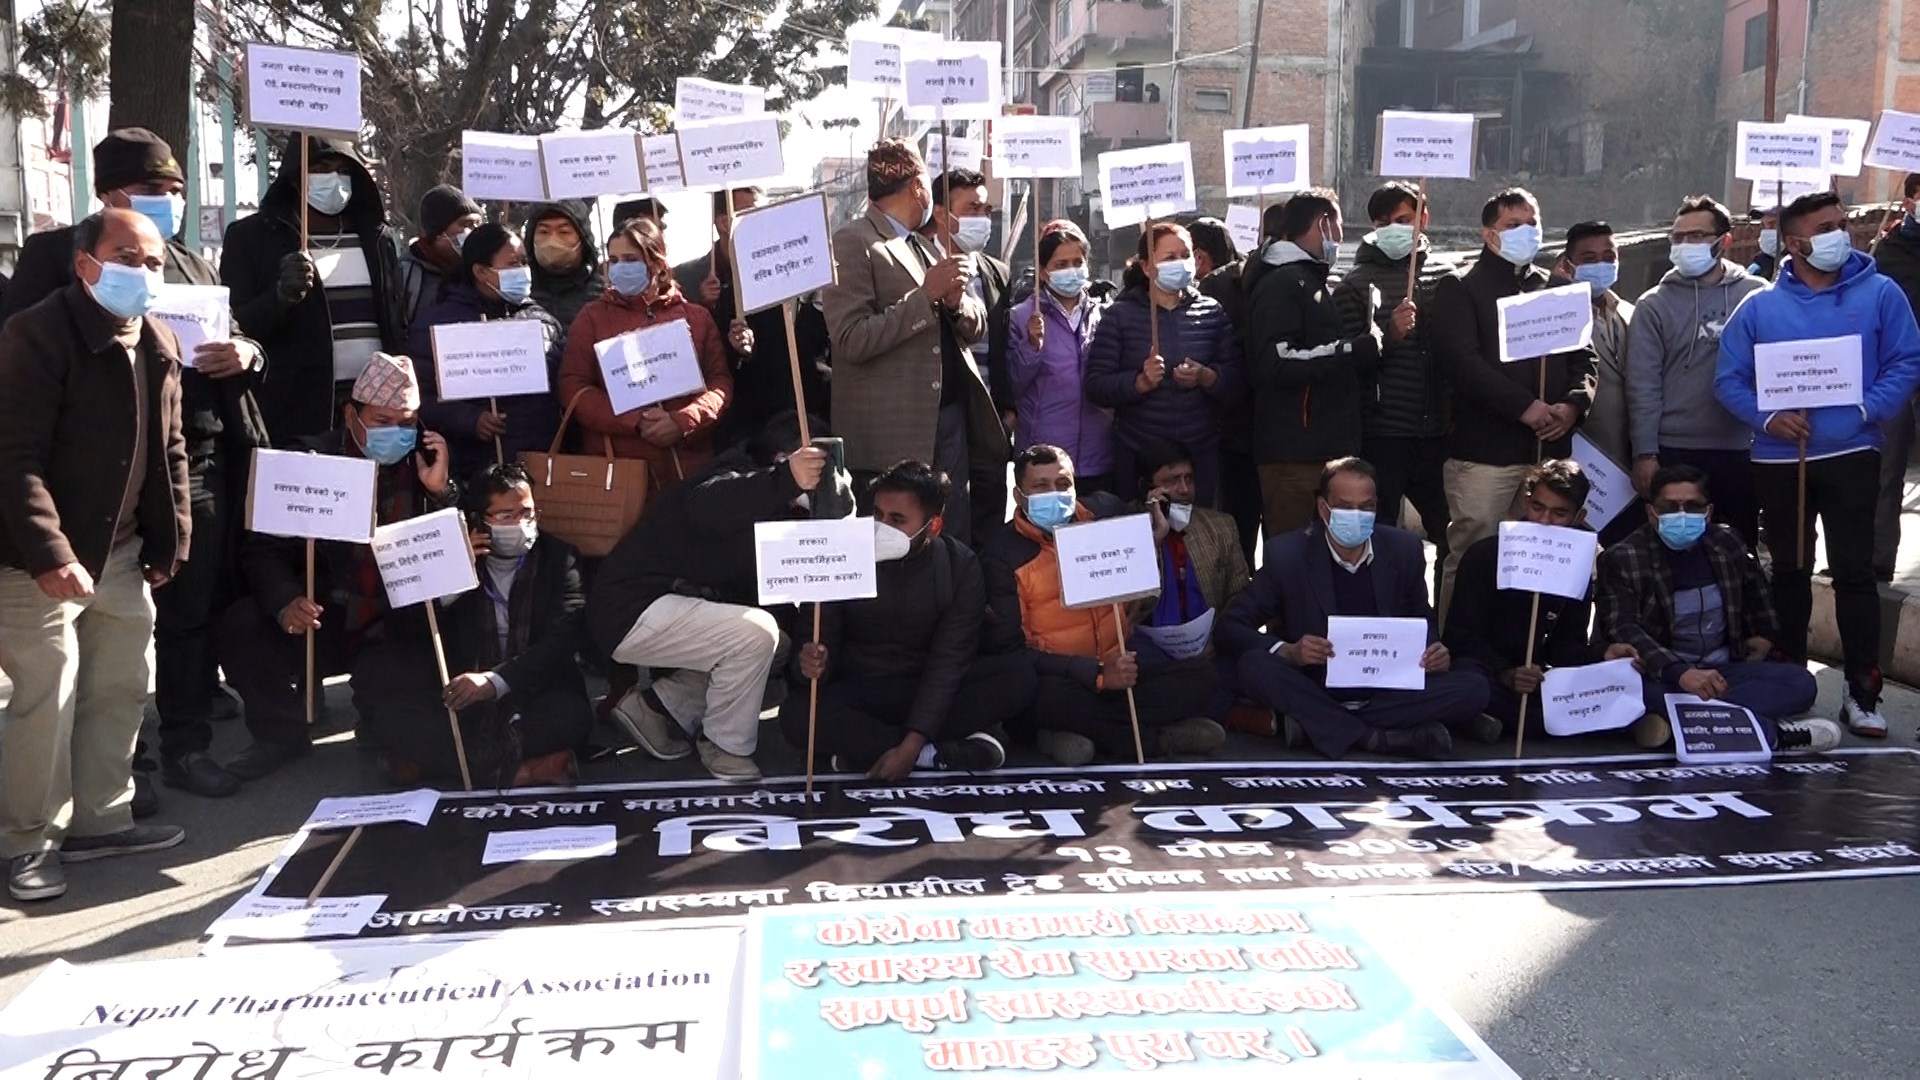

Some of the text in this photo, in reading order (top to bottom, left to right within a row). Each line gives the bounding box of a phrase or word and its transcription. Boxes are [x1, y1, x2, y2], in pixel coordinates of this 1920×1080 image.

[652, 790, 1773, 857] बिरोध कार्यक्रम
[1055, 844, 1133, 865] १२
[1324, 837, 1482, 858] २०७७
[818, 914, 960, 944] कोरोना
[969, 908, 1130, 942] महामारी
[786, 960, 820, 986] र
[990, 945, 1075, 978] सेवा
[1252, 940, 1360, 971] लागि
[81, 967, 712, 1027] Nepal Pharmaceutical Association
[821, 986, 968, 1032] सम्पूर्ण
[355, 1016, 700, 1076] कार्यक्रम
[1101, 1030, 1188, 1071] पुरा
